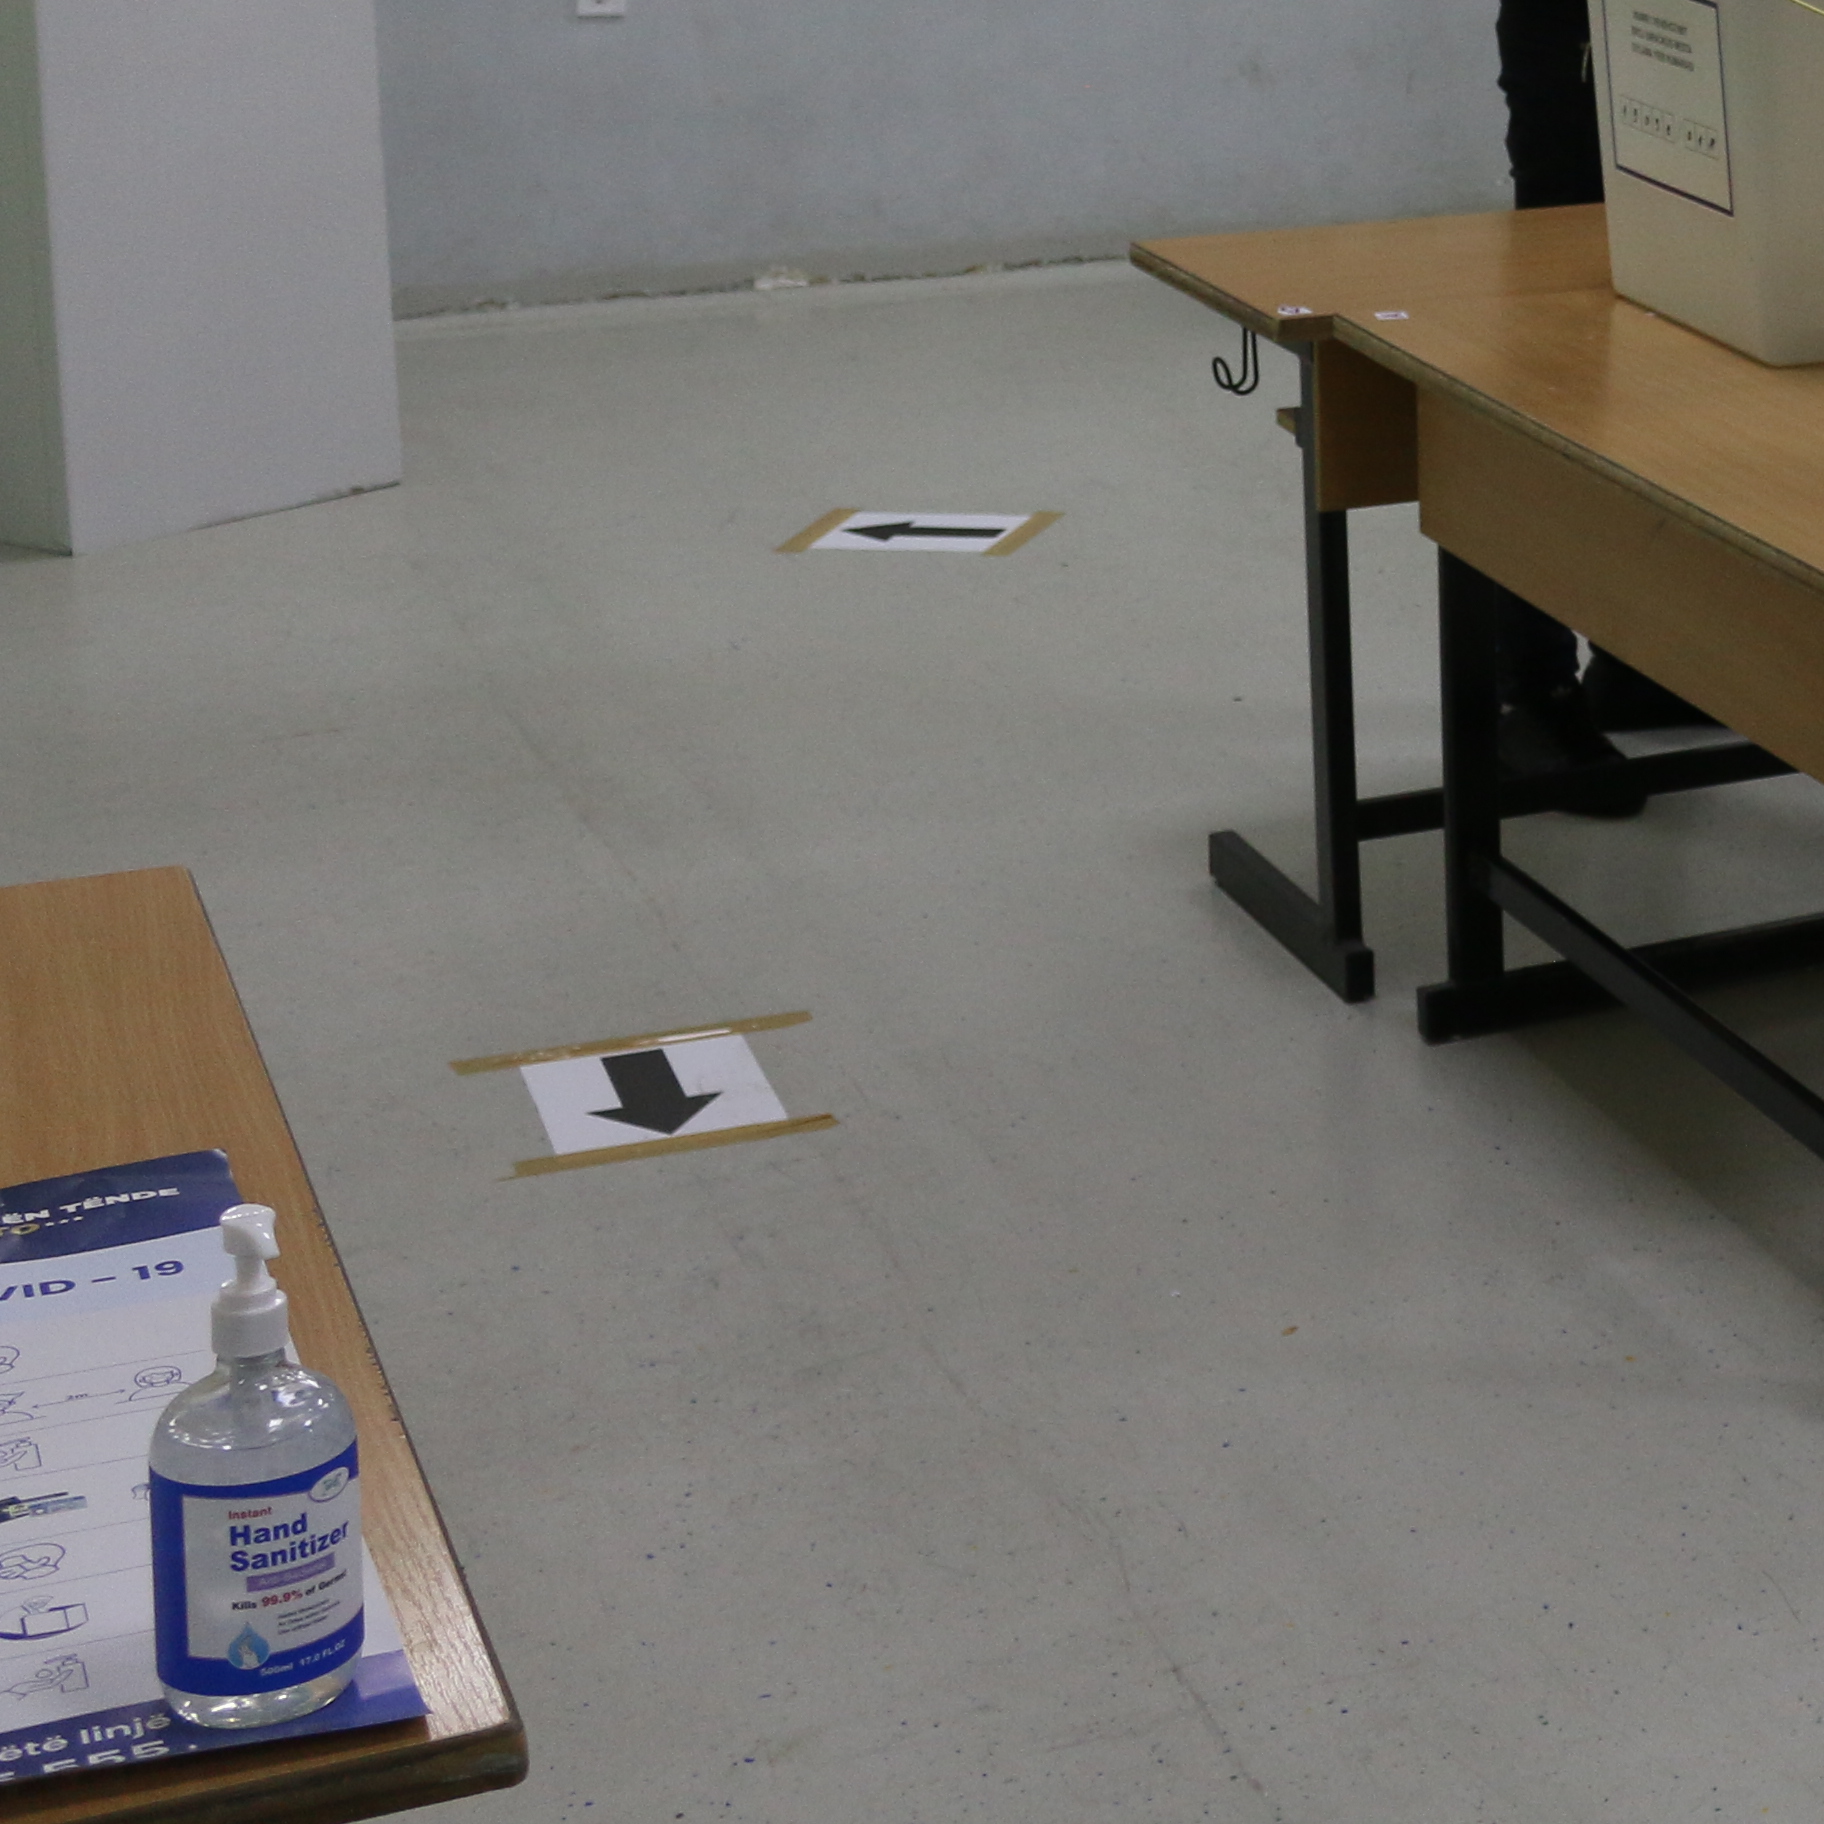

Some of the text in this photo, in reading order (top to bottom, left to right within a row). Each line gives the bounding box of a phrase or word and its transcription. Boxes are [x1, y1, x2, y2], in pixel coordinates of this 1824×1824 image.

[60, 1187, 180, 1214] TËNDE
[132, 1260, 184, 1280] 19
[228, 1507, 273, 1521] Instant
[230, 1512, 308, 1547] Hand
[231, 1521, 349, 1572] Sanitizer
[232, 1601, 257, 1611] Kills
[261, 1589, 303, 1608] 99.9%
[305, 1585, 316, 1597] of
[79, 1713, 172, 1745] linjë
